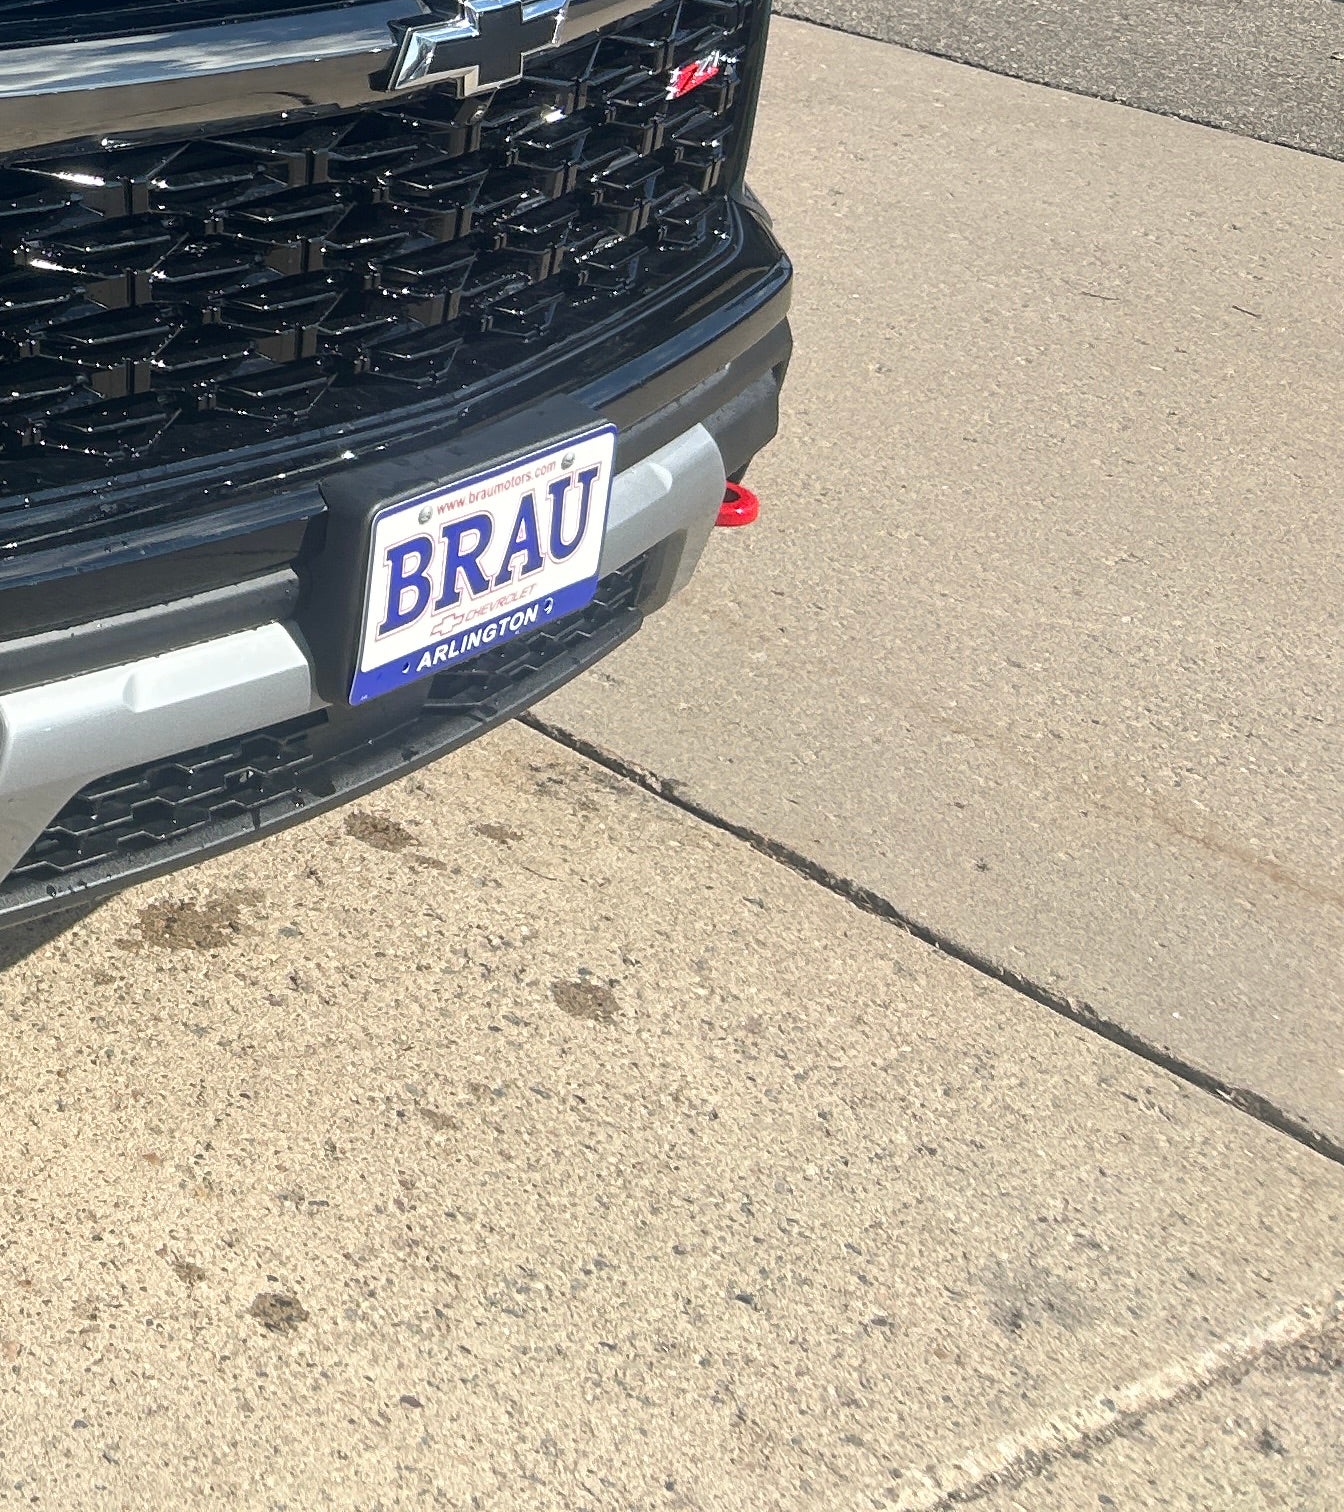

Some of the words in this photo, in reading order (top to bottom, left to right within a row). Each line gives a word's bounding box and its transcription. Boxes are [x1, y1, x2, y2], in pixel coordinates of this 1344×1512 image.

[436, 460, 557, 516] www.braumotors.com
[376, 463, 601, 640] BRAU
[465, 583, 538, 622] CHEVROLET
[416, 604, 540, 672] ARLINGTON
